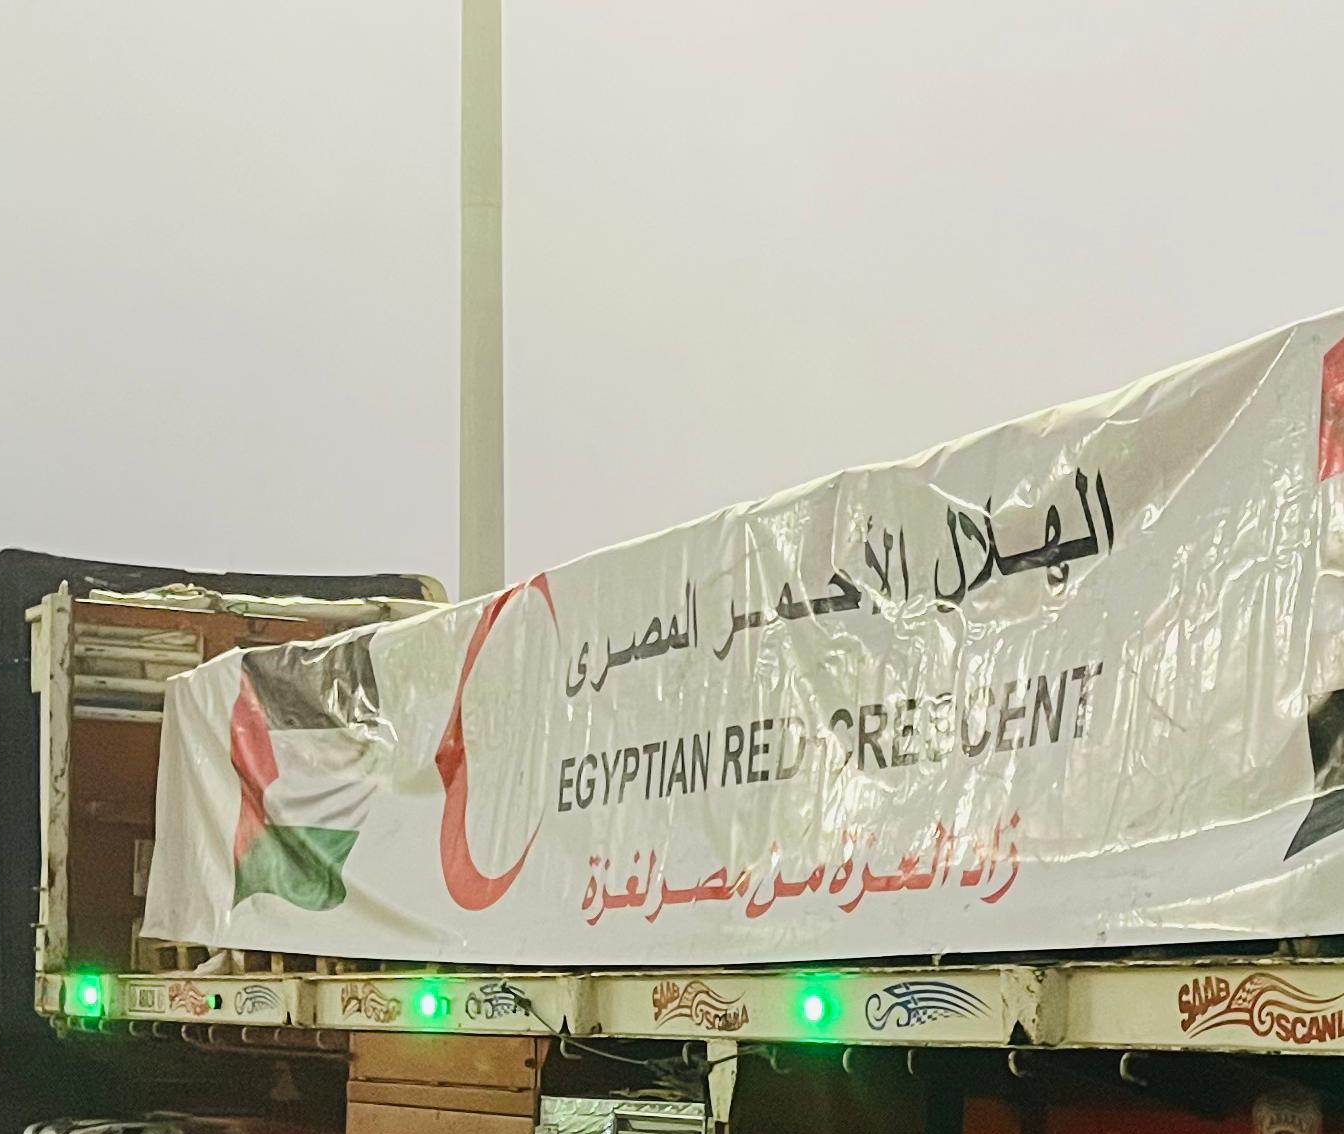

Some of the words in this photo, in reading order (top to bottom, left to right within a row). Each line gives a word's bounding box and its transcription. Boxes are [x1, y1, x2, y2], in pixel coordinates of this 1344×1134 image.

[713, 514, 910, 660] الأحمر
[934, 466, 1115, 614] الهلال
[557, 731, 711, 812] EGYPTIAN
[720, 708, 806, 788] RED
[645, 864, 751, 923] مصر
[745, 840, 826, 919] من
[960, 809, 1022, 905] زاد
[1178, 976, 1230, 1032] SAAB
